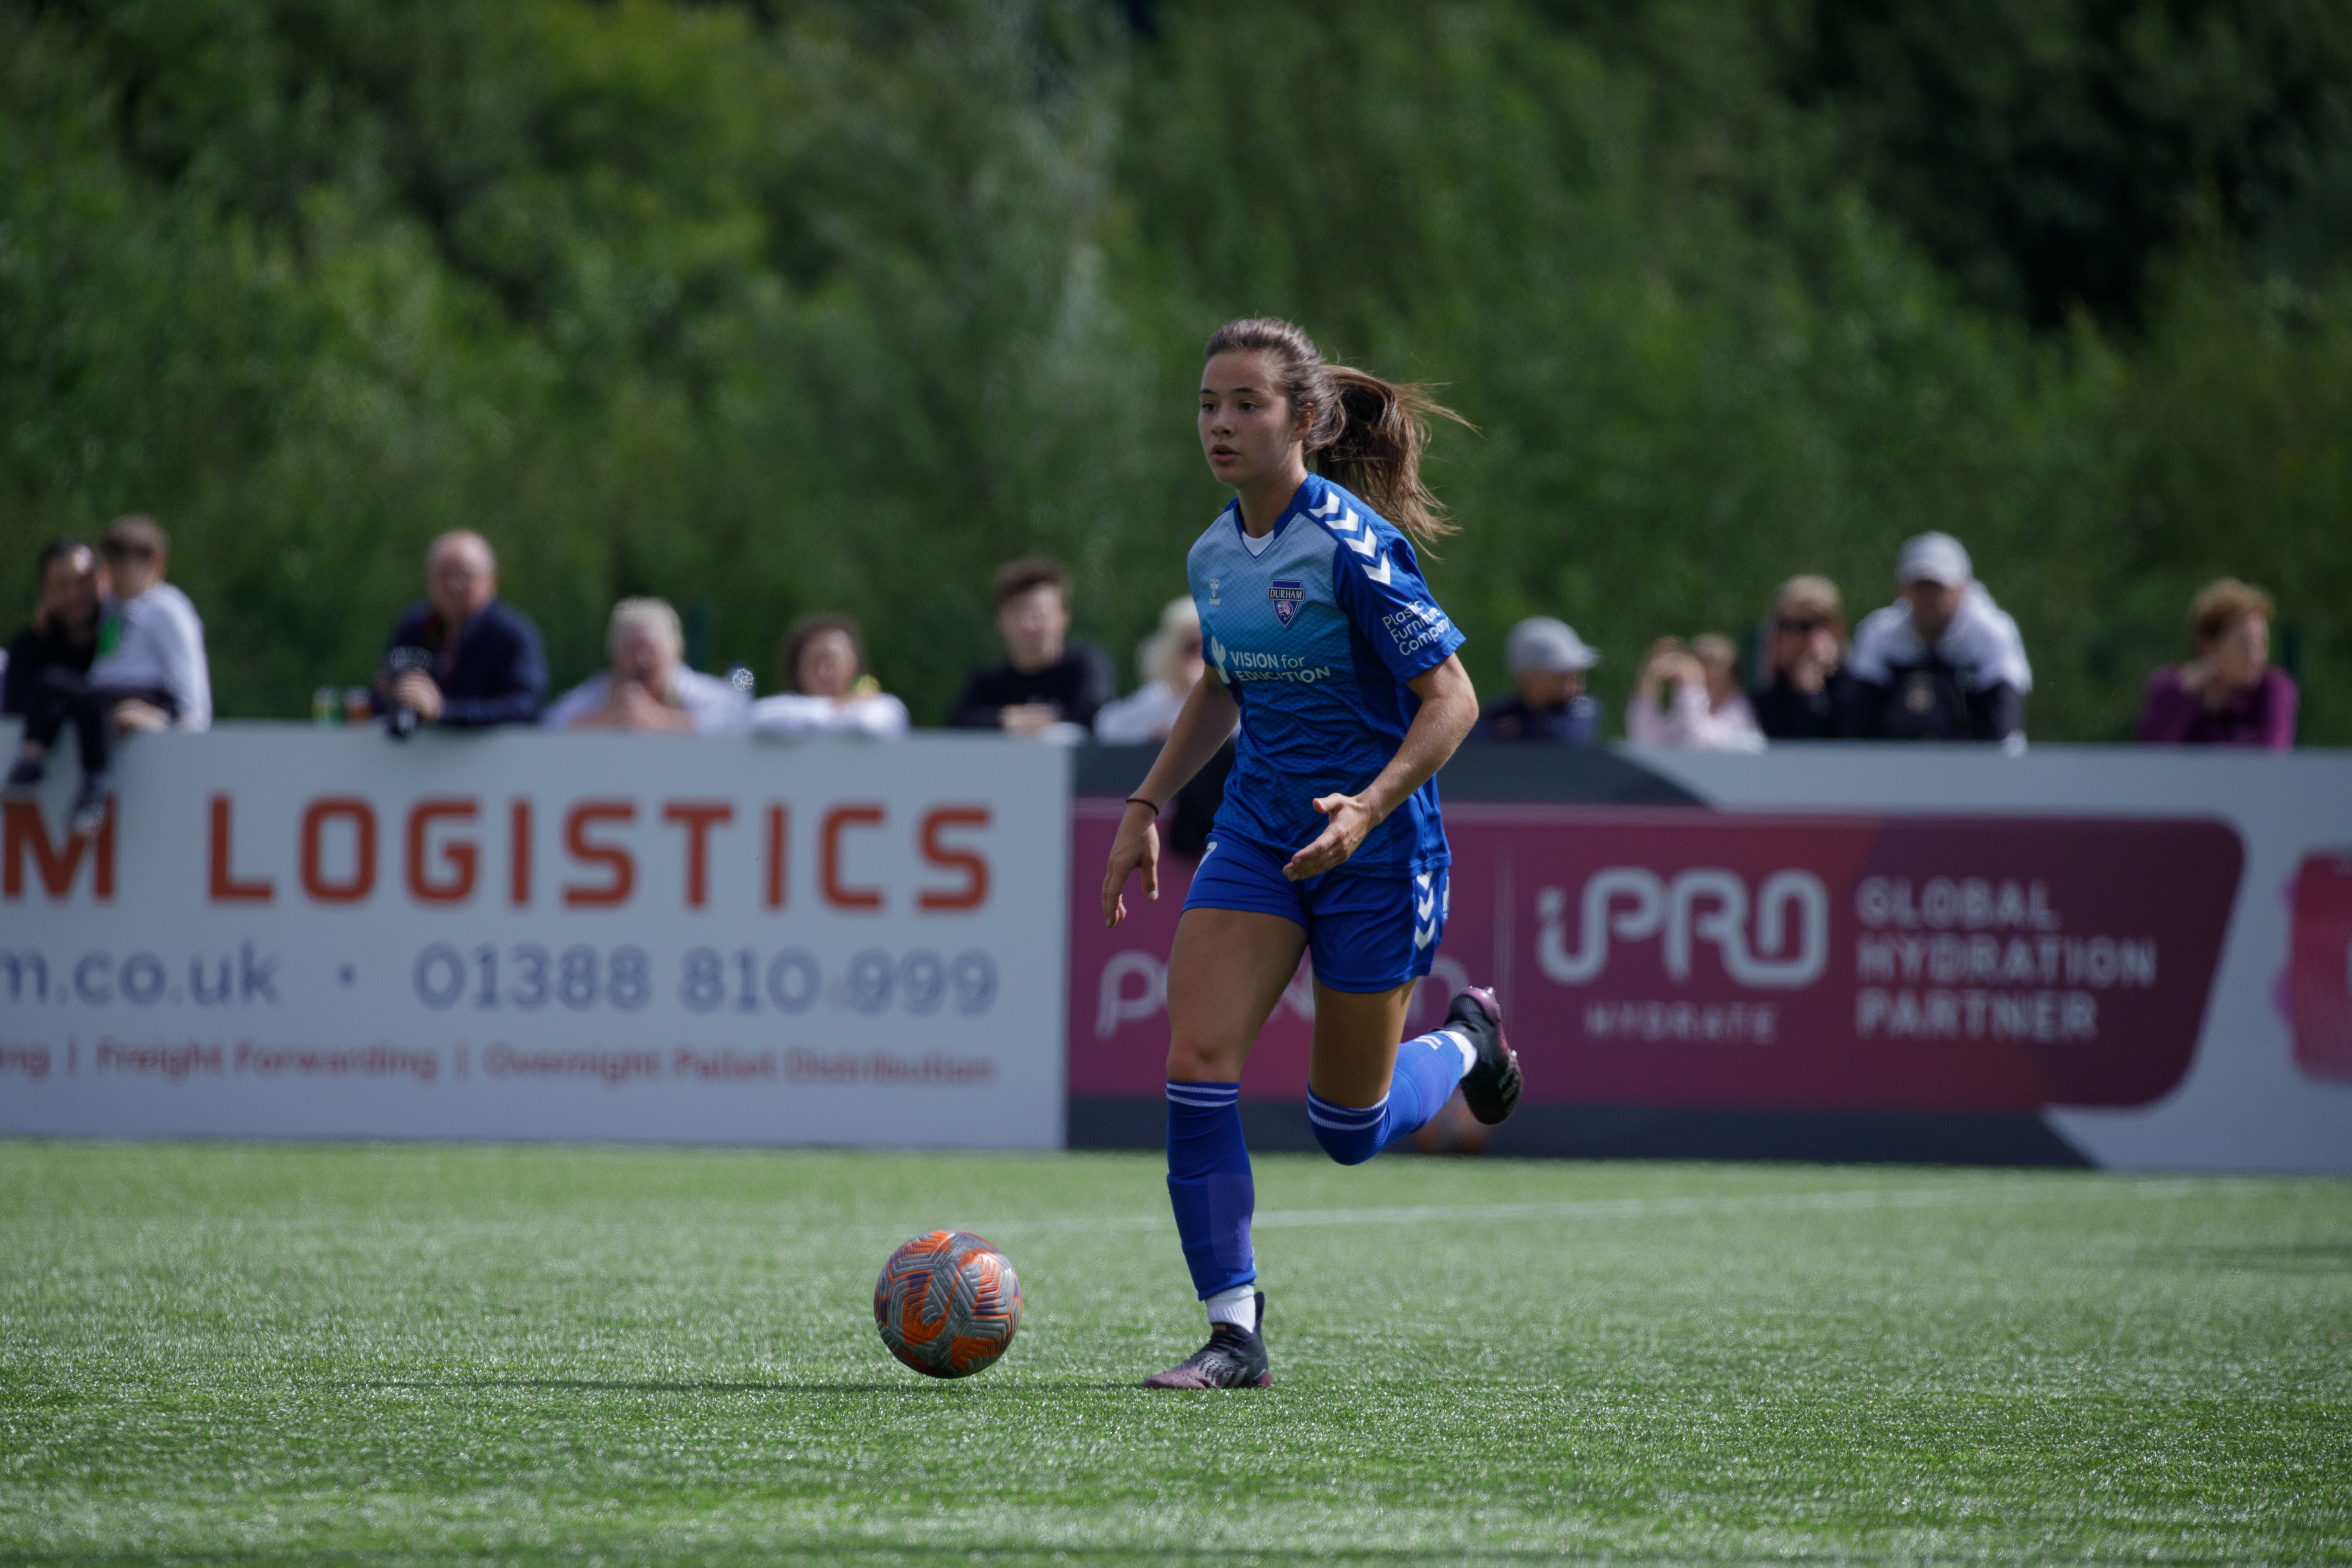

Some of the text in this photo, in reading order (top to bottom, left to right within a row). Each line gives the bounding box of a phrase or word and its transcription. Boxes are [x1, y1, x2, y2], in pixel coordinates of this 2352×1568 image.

[1270, 589, 1302, 599] DURHAM
[1382, 601, 1424, 630] Plastic
[1390, 607, 1441, 644] Furniture
[1399, 616, 1450, 655] Company
[1229, 651, 1305, 668] VISION for
[207, 791, 994, 912] LOGISTICS
[1855, 875, 2063, 931] GLOBAL
[412, 942, 650, 1013] 01388
[682, 944, 822, 1016] 810
[847, 946, 999, 1019] 999
[1855, 932, 2158, 990] HYDRATION
[1855, 987, 2098, 1044] PARTNER
[96, 1034, 223, 1086] Freight
[234, 1037, 441, 1089] Forwarding
